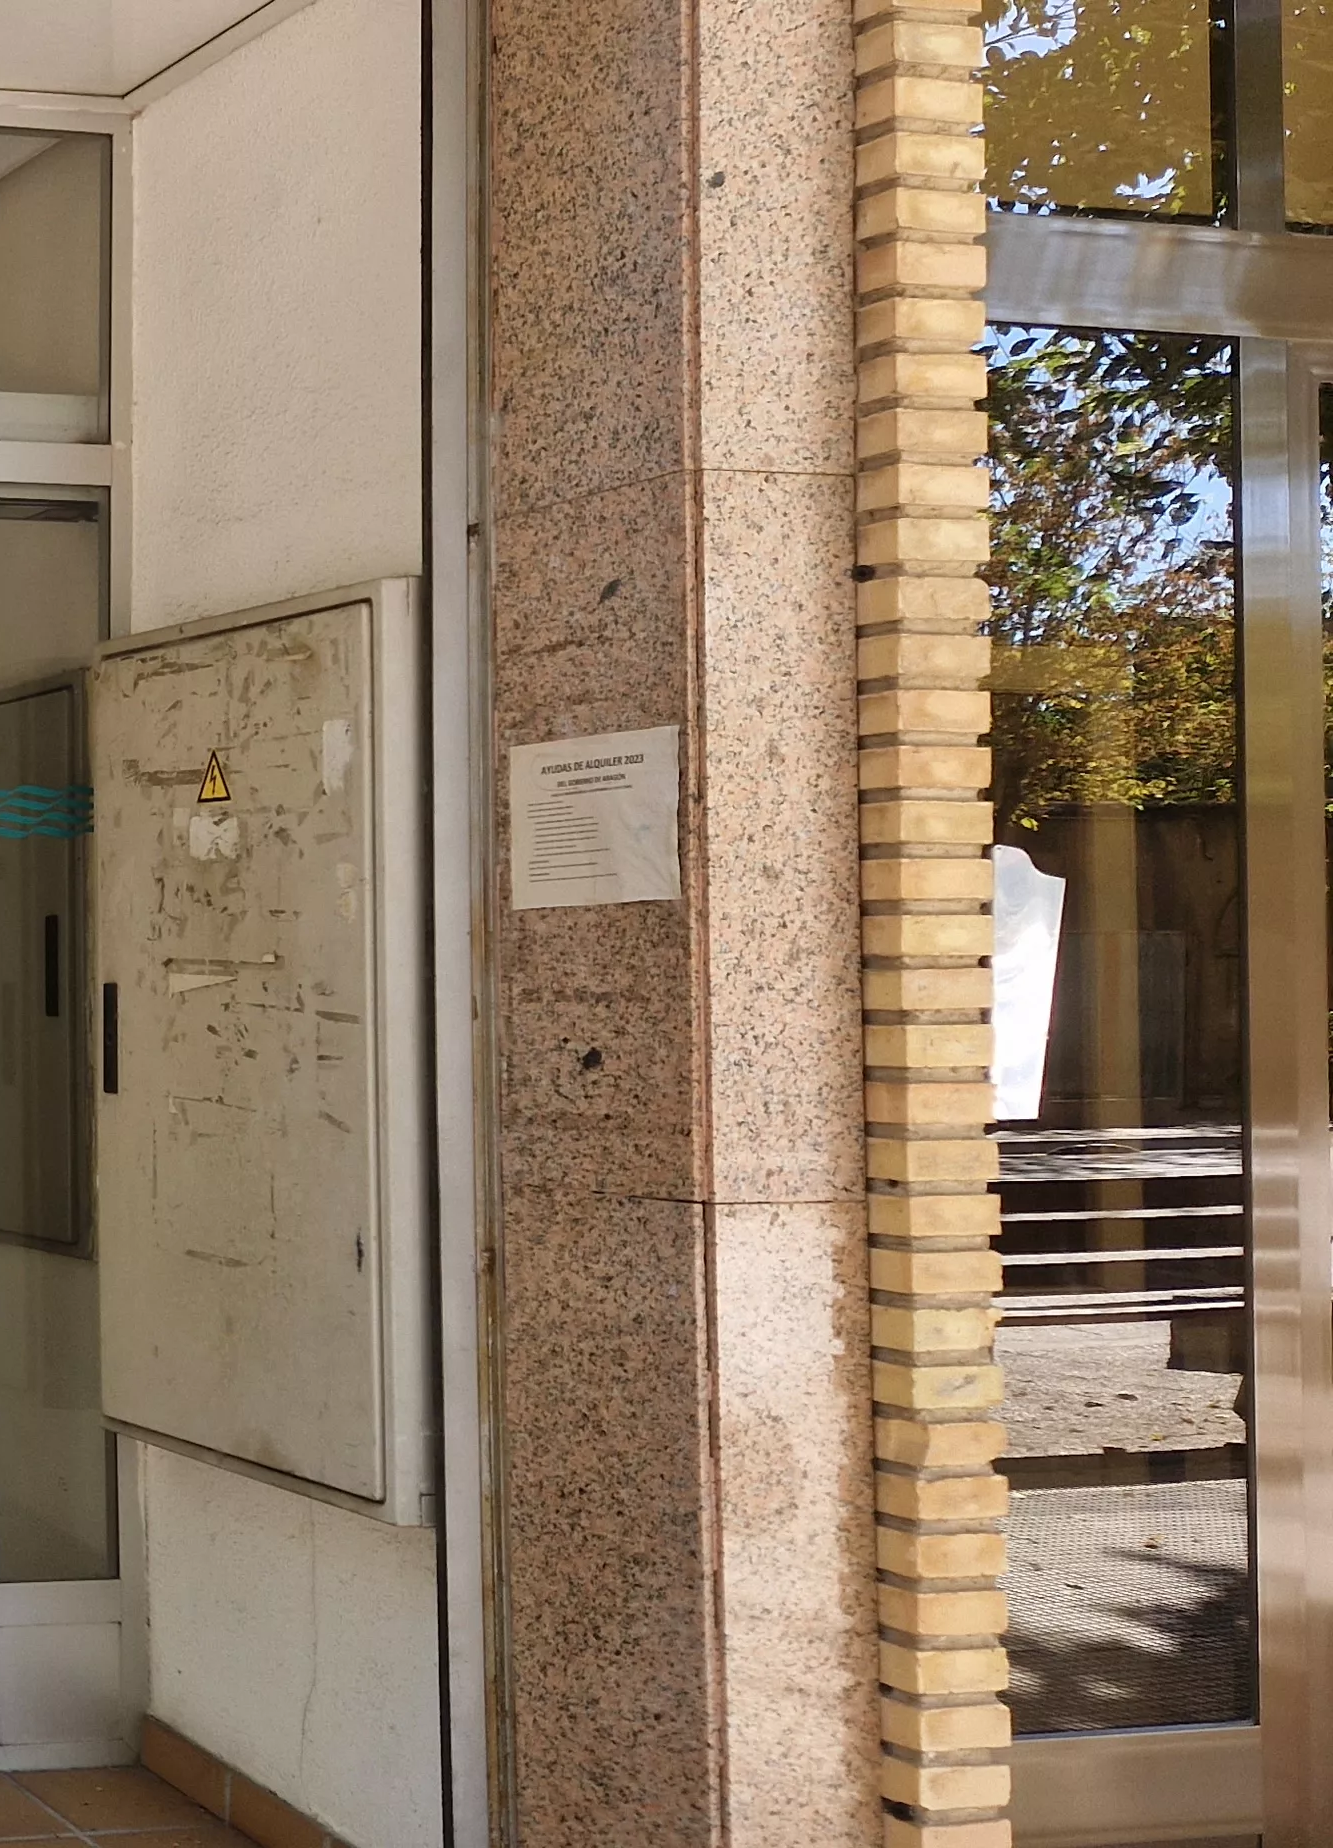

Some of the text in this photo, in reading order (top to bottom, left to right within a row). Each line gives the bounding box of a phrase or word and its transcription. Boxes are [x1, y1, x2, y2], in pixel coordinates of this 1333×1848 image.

[541, 754, 644, 775] AYUDAS DE ALQUILER 2023
